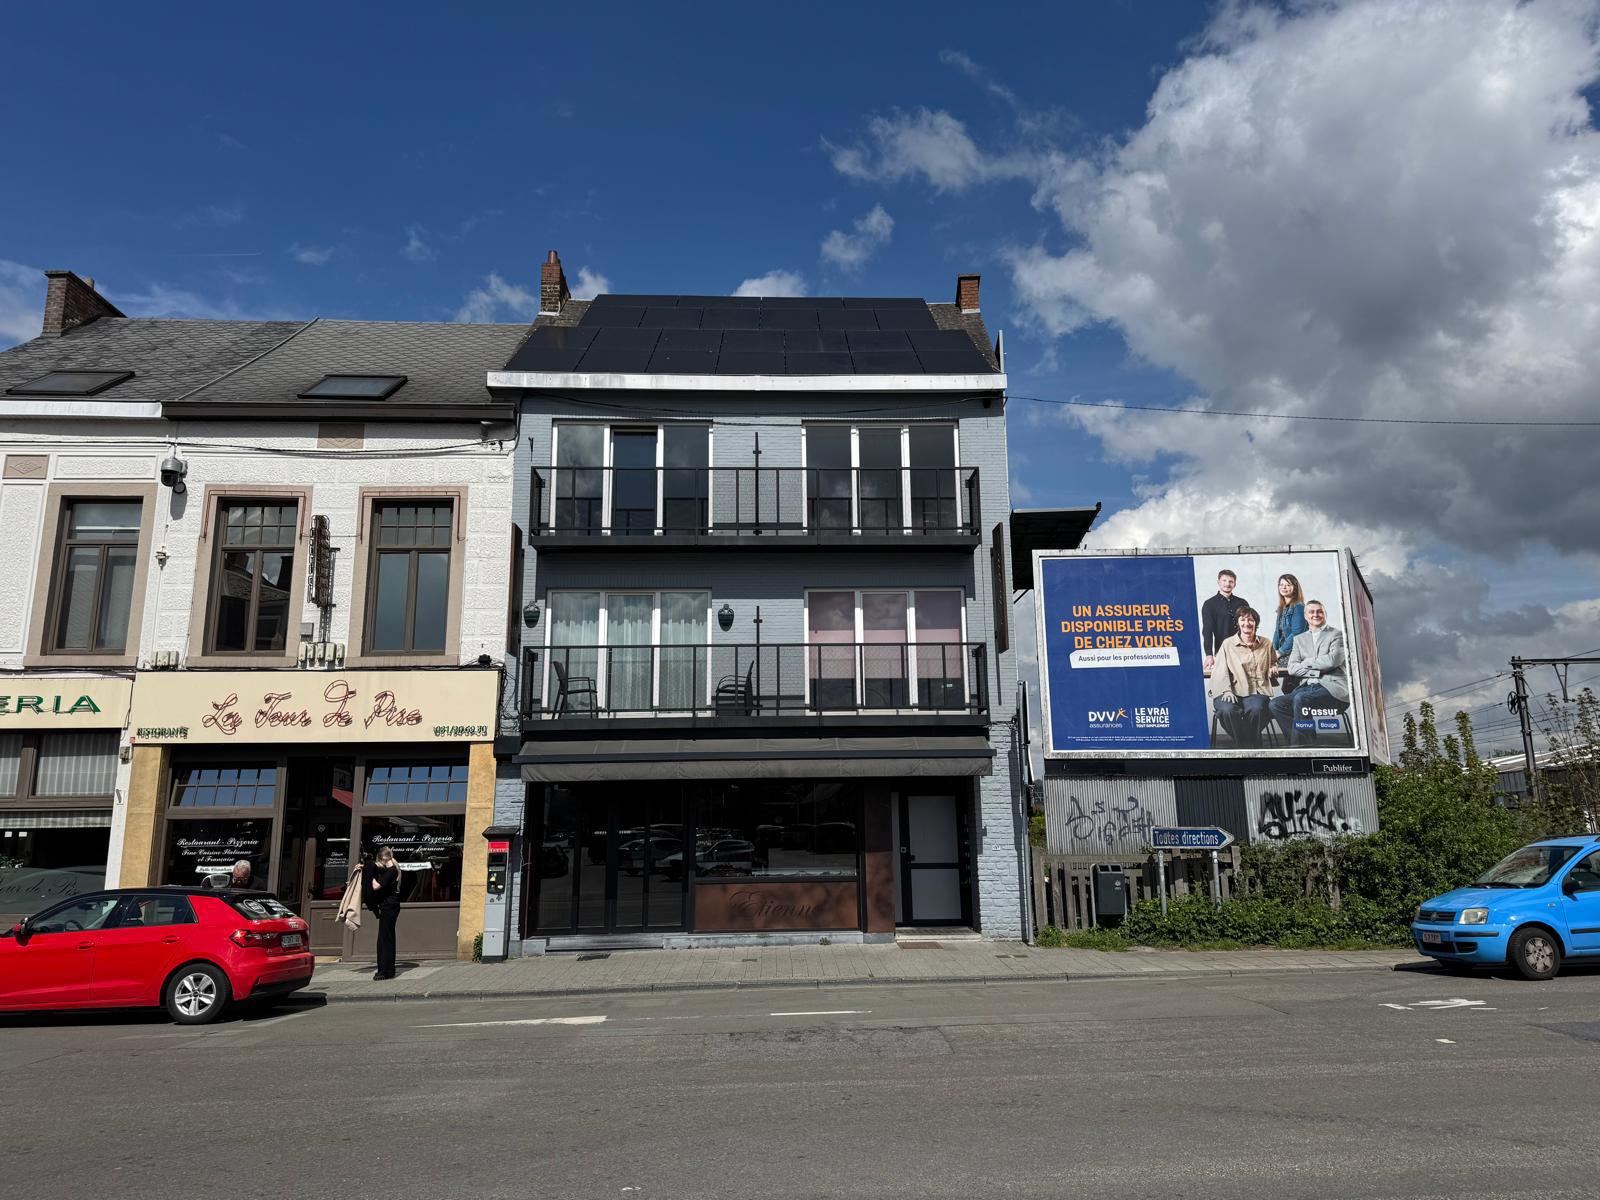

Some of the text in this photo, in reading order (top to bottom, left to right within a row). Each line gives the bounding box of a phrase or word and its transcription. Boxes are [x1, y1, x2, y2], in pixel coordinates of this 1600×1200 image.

[1072, 604, 1170, 617] UN ASSUREUR
[1061, 616, 1184, 633] DISPONIBLE PRÈS
[1074, 635, 1173, 649] DE CHEZ VOUS
[1123, 653, 1171, 661] professionnels
[1088, 711, 1115, 722] DVV
[1134, 707, 1169, 716] LE VRAI
[1301, 707, 1338, 716] G'assur
[1135, 715, 1170, 724] SERVICE
[1323, 764, 1352, 772] Publifer
[372, 835, 416, 845] Restaurant
[1154, 829, 1219, 845] Toutes directions
[177, 838, 221, 848] Restaurant
